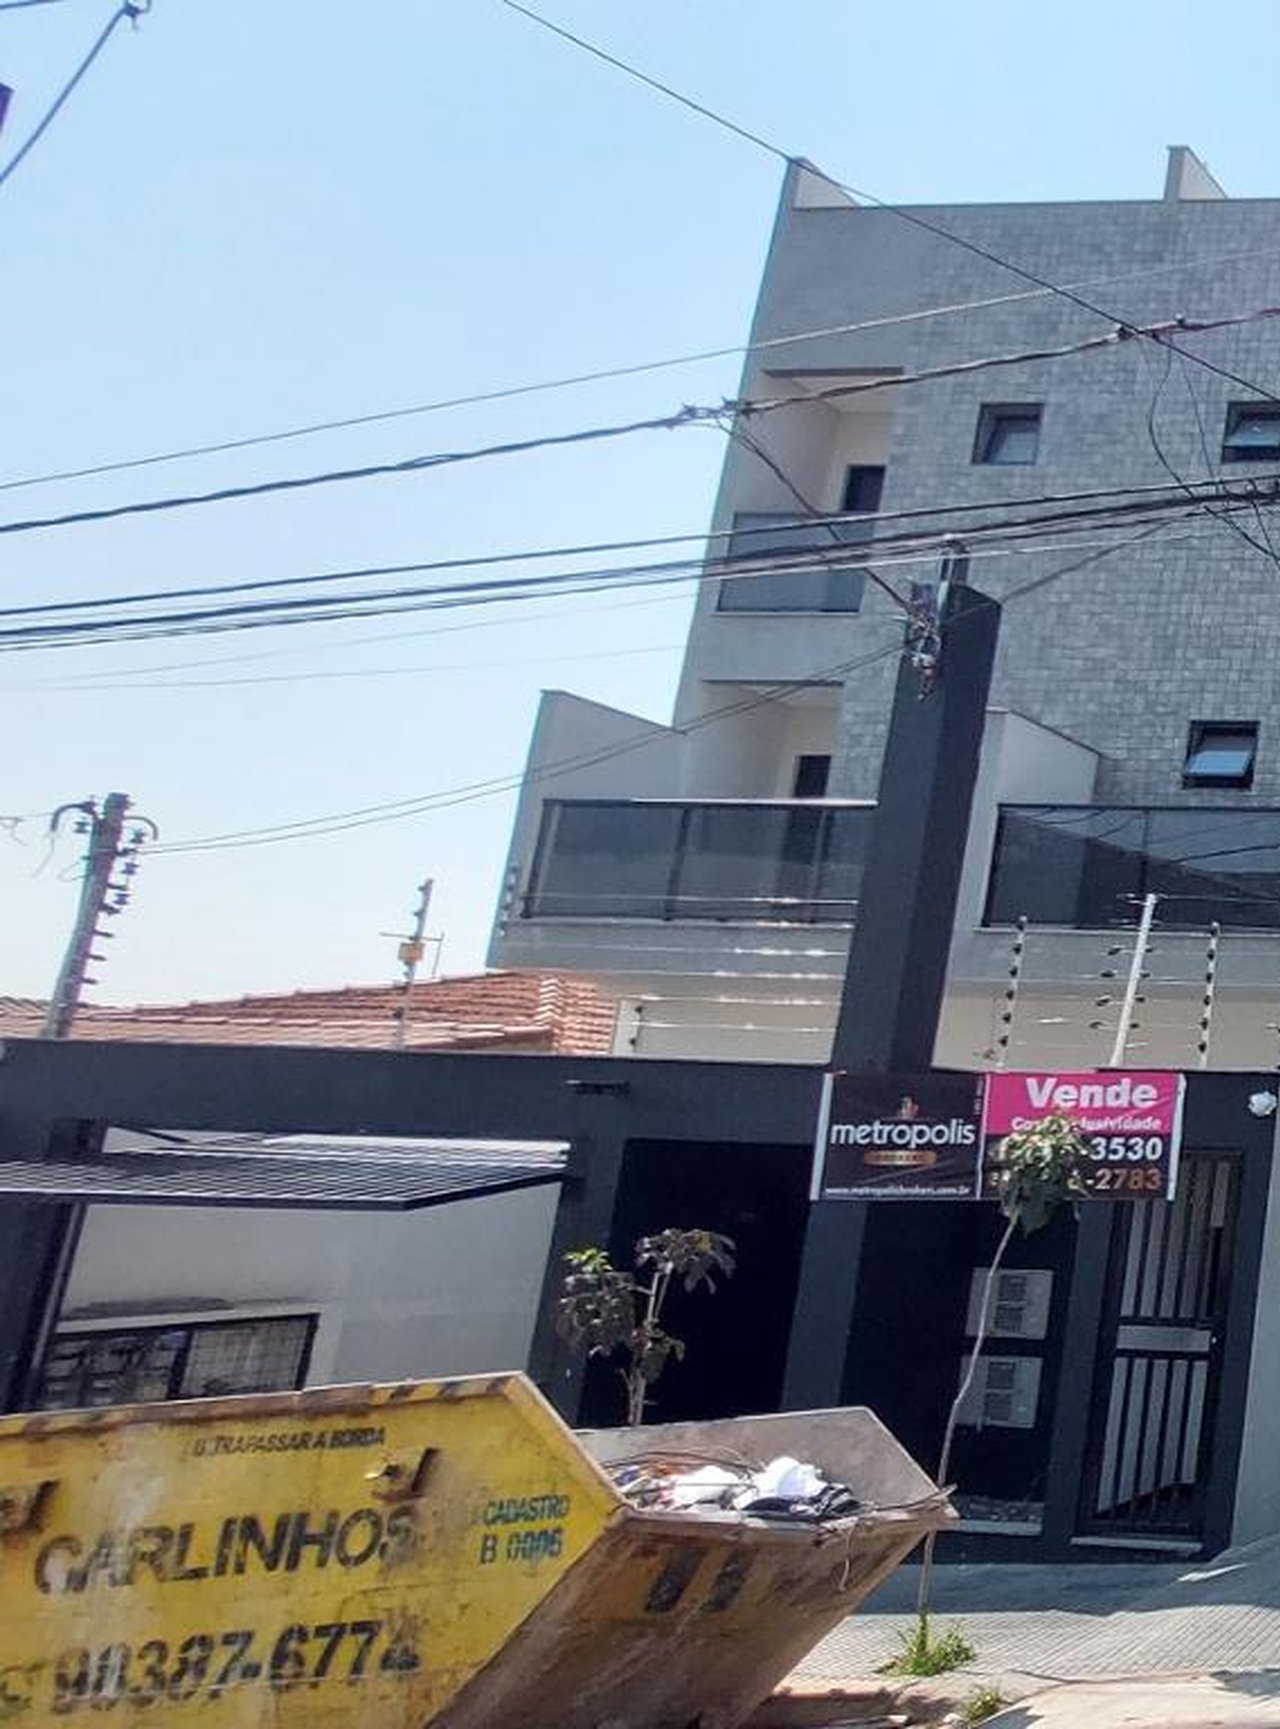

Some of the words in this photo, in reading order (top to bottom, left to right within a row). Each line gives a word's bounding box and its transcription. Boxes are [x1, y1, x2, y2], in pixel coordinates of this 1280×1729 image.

[1025, 1077, 1159, 1109] Vende
[830, 1118, 976, 1149] metropolis
[33, 1505, 420, 1594] CARLINHOS
